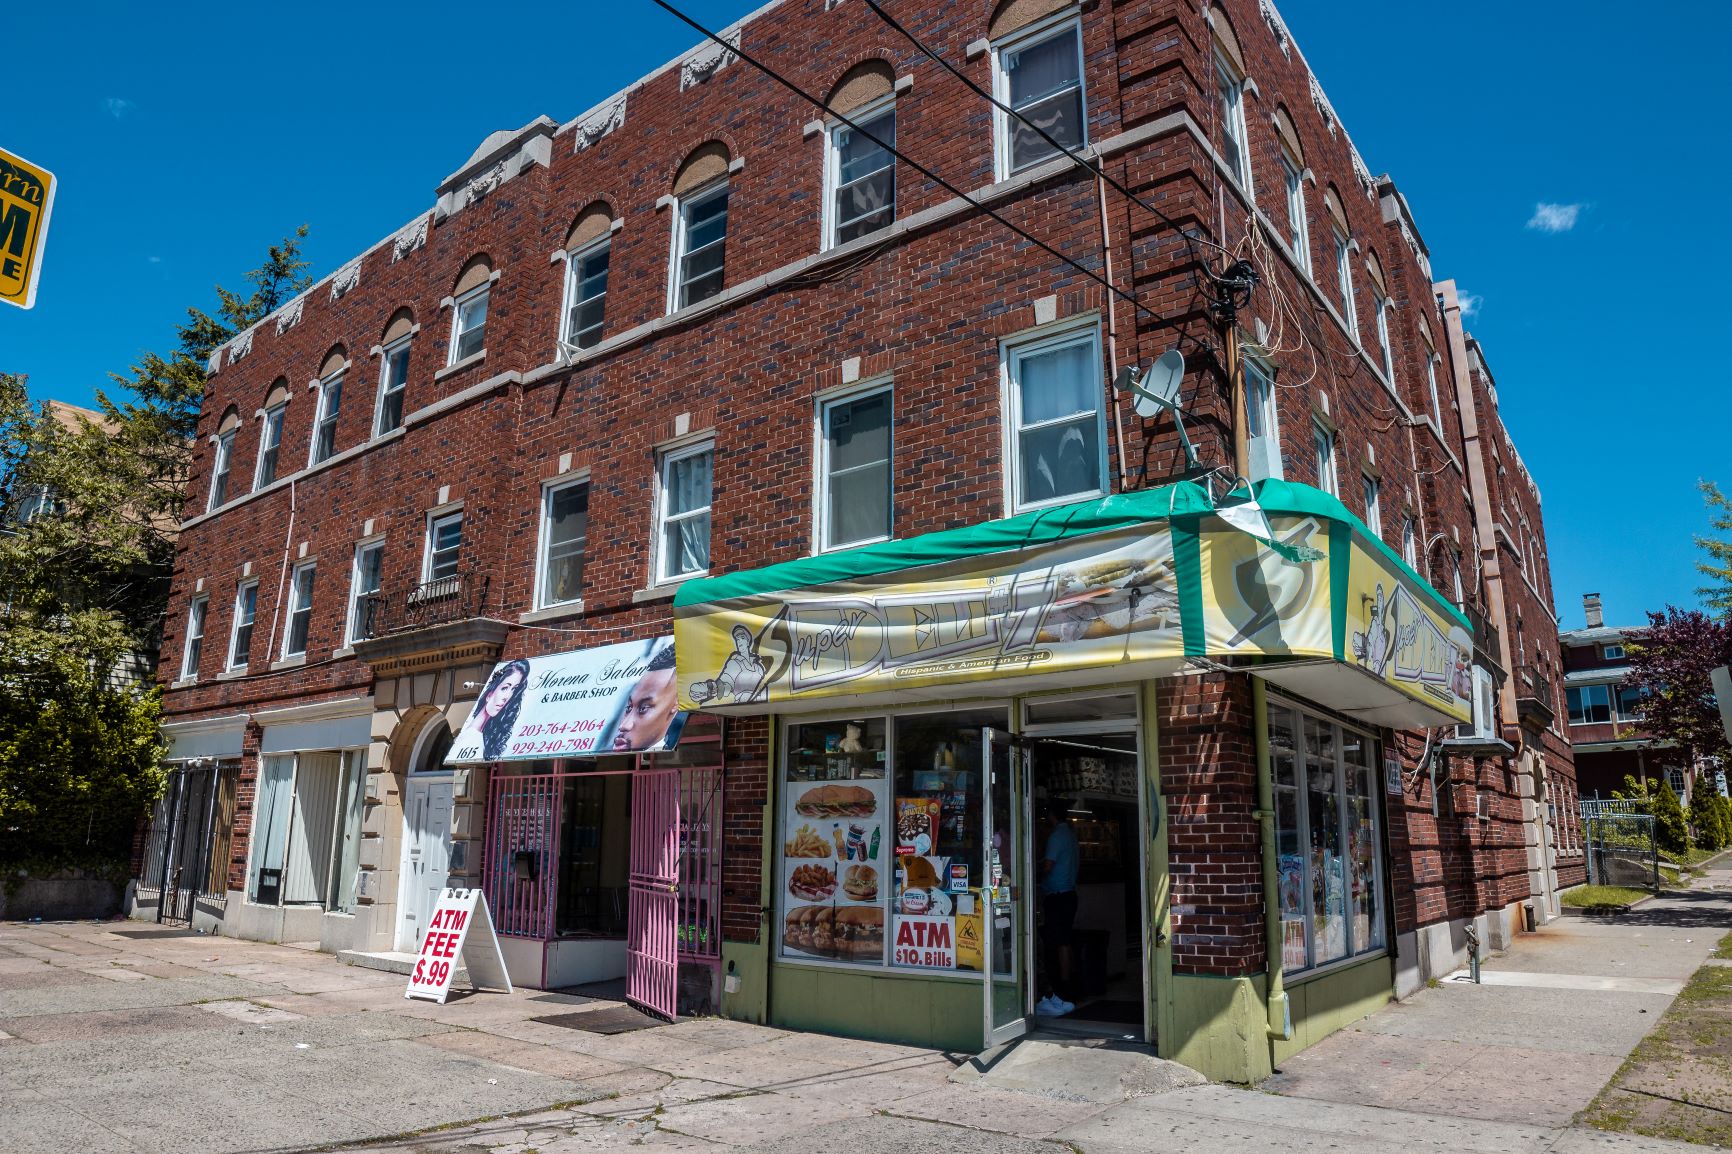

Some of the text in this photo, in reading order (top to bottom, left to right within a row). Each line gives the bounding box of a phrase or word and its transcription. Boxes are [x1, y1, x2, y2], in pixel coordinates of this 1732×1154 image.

[528, 658, 650, 690] Morena Salon
[900, 663, 944, 676] Hispanic
[959, 656, 1011, 669] American
[1014, 652, 1045, 662] Food
[541, 686, 618, 704] & BARBER SHOP
[518, 718, 605, 738] 203-764-2064
[456, 746, 477, 760] 1615
[512, 737, 595, 755] 929-240-7981
[430, 909, 468, 930] ATM
[421, 931, 460, 958] FEE
[896, 921, 951, 948] ATM
[925, 951, 952, 966] Bills
[412, 958, 449, 986] $.99
